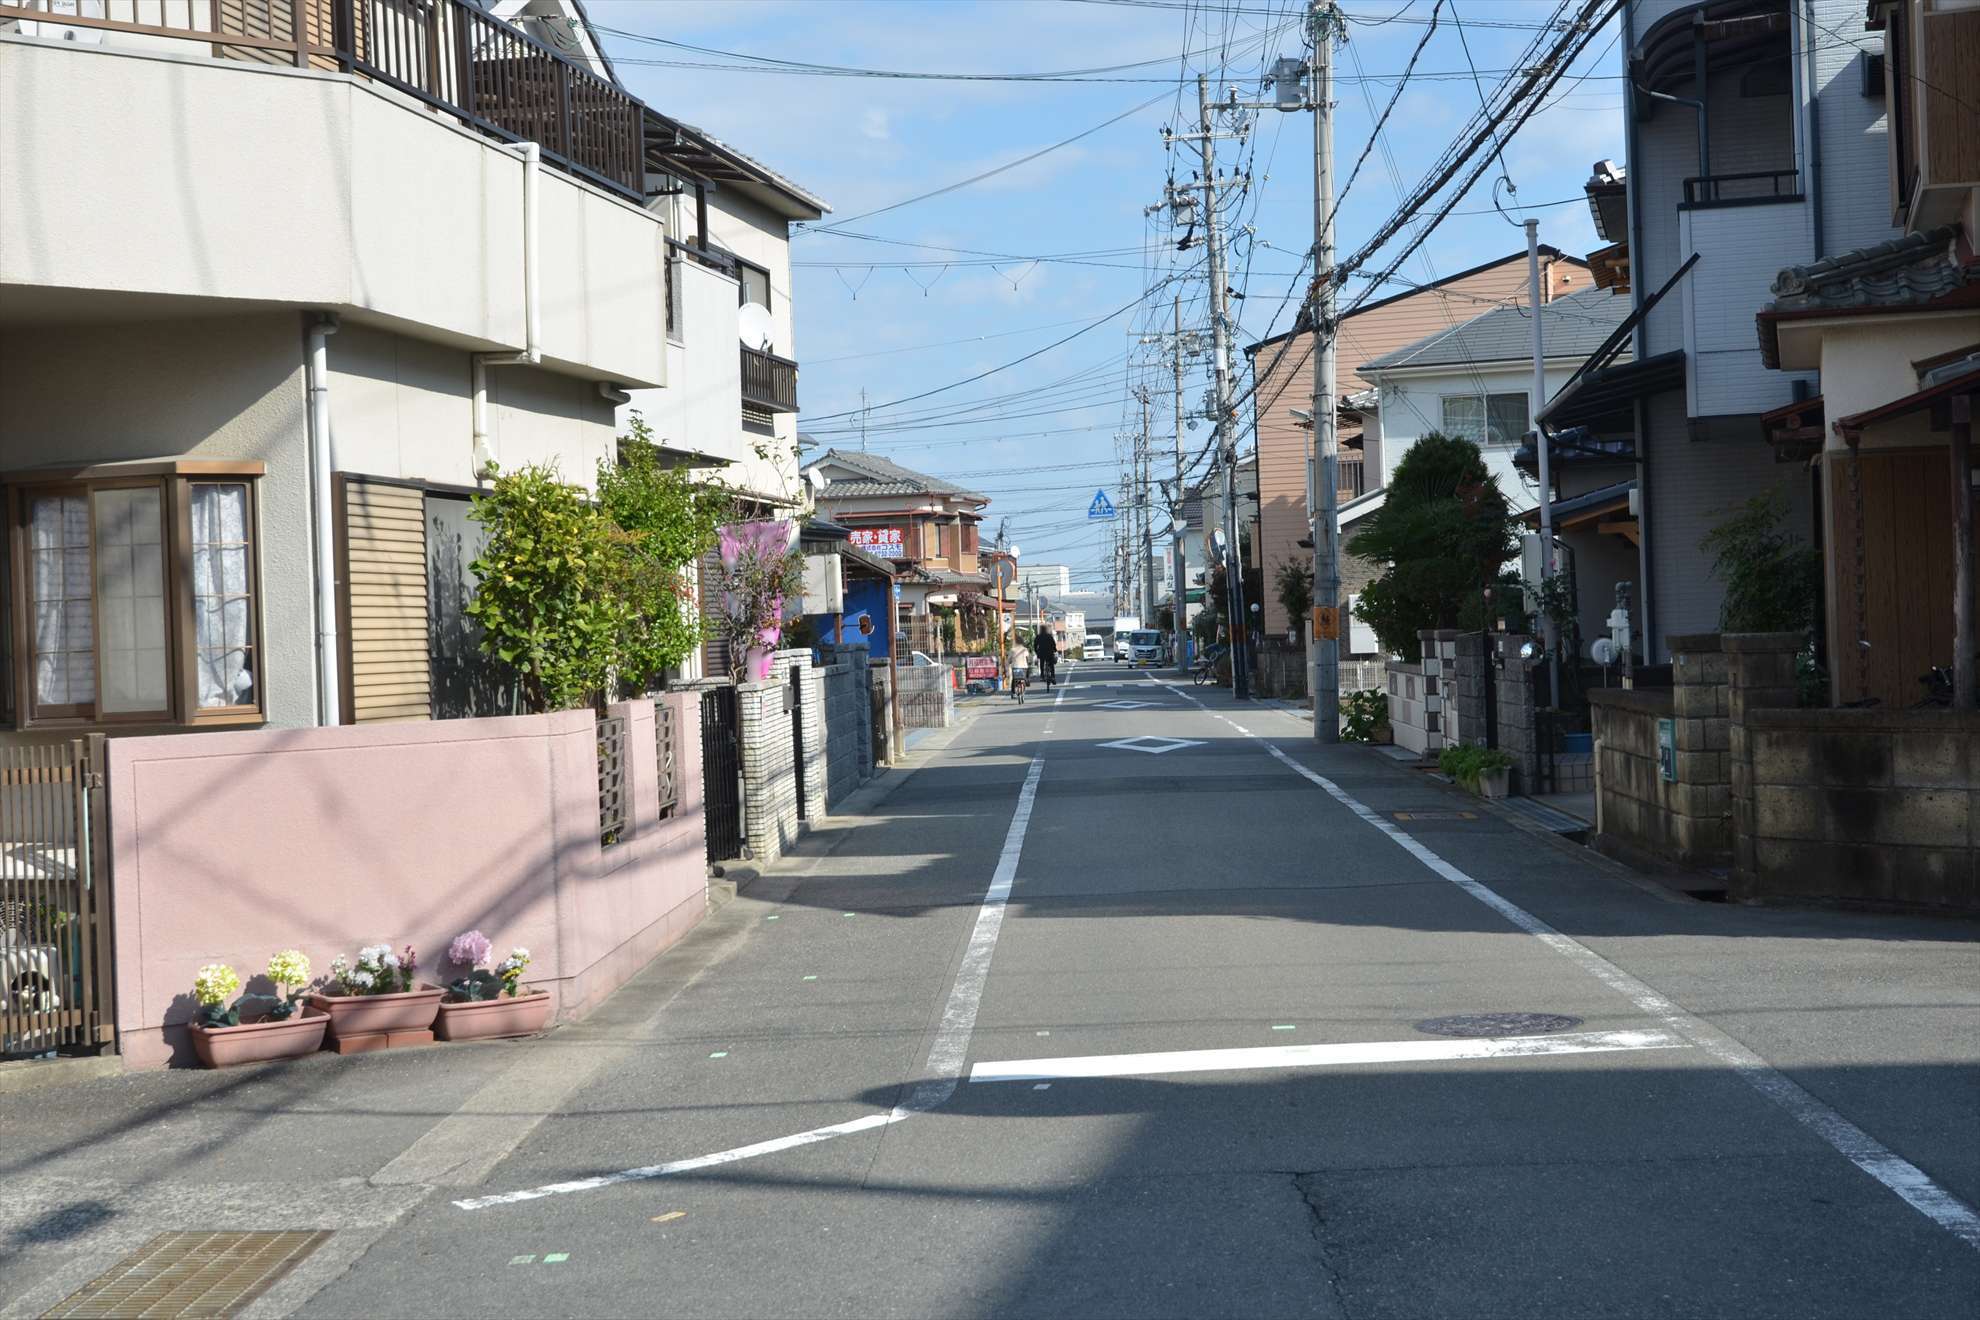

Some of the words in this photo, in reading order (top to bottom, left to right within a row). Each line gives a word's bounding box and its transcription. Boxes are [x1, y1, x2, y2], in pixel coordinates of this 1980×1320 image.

[850, 529, 902, 544] 売家・貸家
